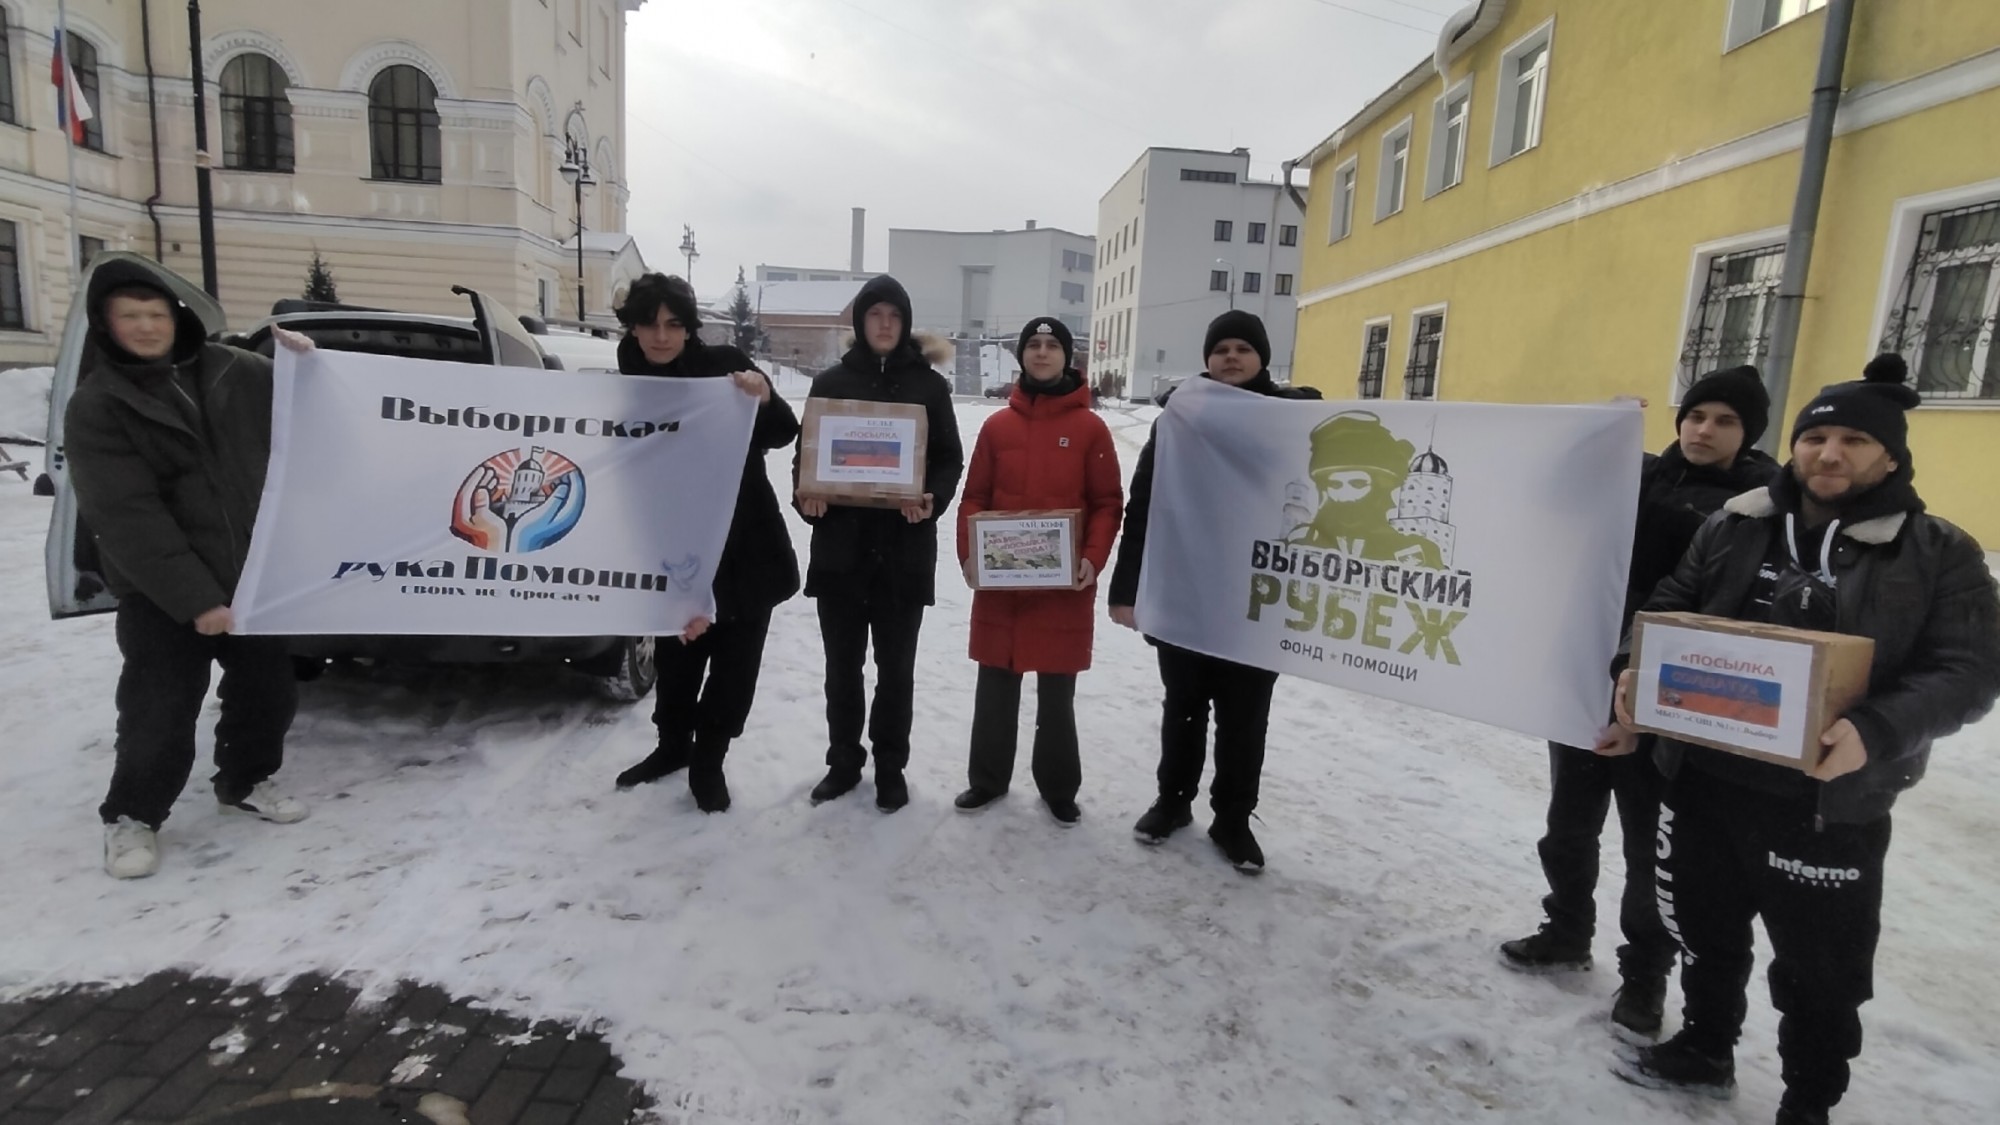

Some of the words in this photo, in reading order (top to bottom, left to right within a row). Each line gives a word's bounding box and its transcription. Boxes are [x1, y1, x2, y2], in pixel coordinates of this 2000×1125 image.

[381, 396, 679, 438] Выборгская
[401, 585, 465, 596] своих
[475, 588, 501, 597] не
[510, 588, 600, 601] бросаем
[1251, 540, 1472, 608] ВЫБОРГСКИЙ
[1246, 573, 1468, 666] РУБЕЖ
[1279, 639, 1324, 661] ФОНД
[1342, 652, 1418, 682] ПОМОЩИ
[1681, 653, 1775, 676] «ПОСЫЛКА
[1656, 801, 1675, 860] NO
[1768, 851, 1860, 880] Inferno
